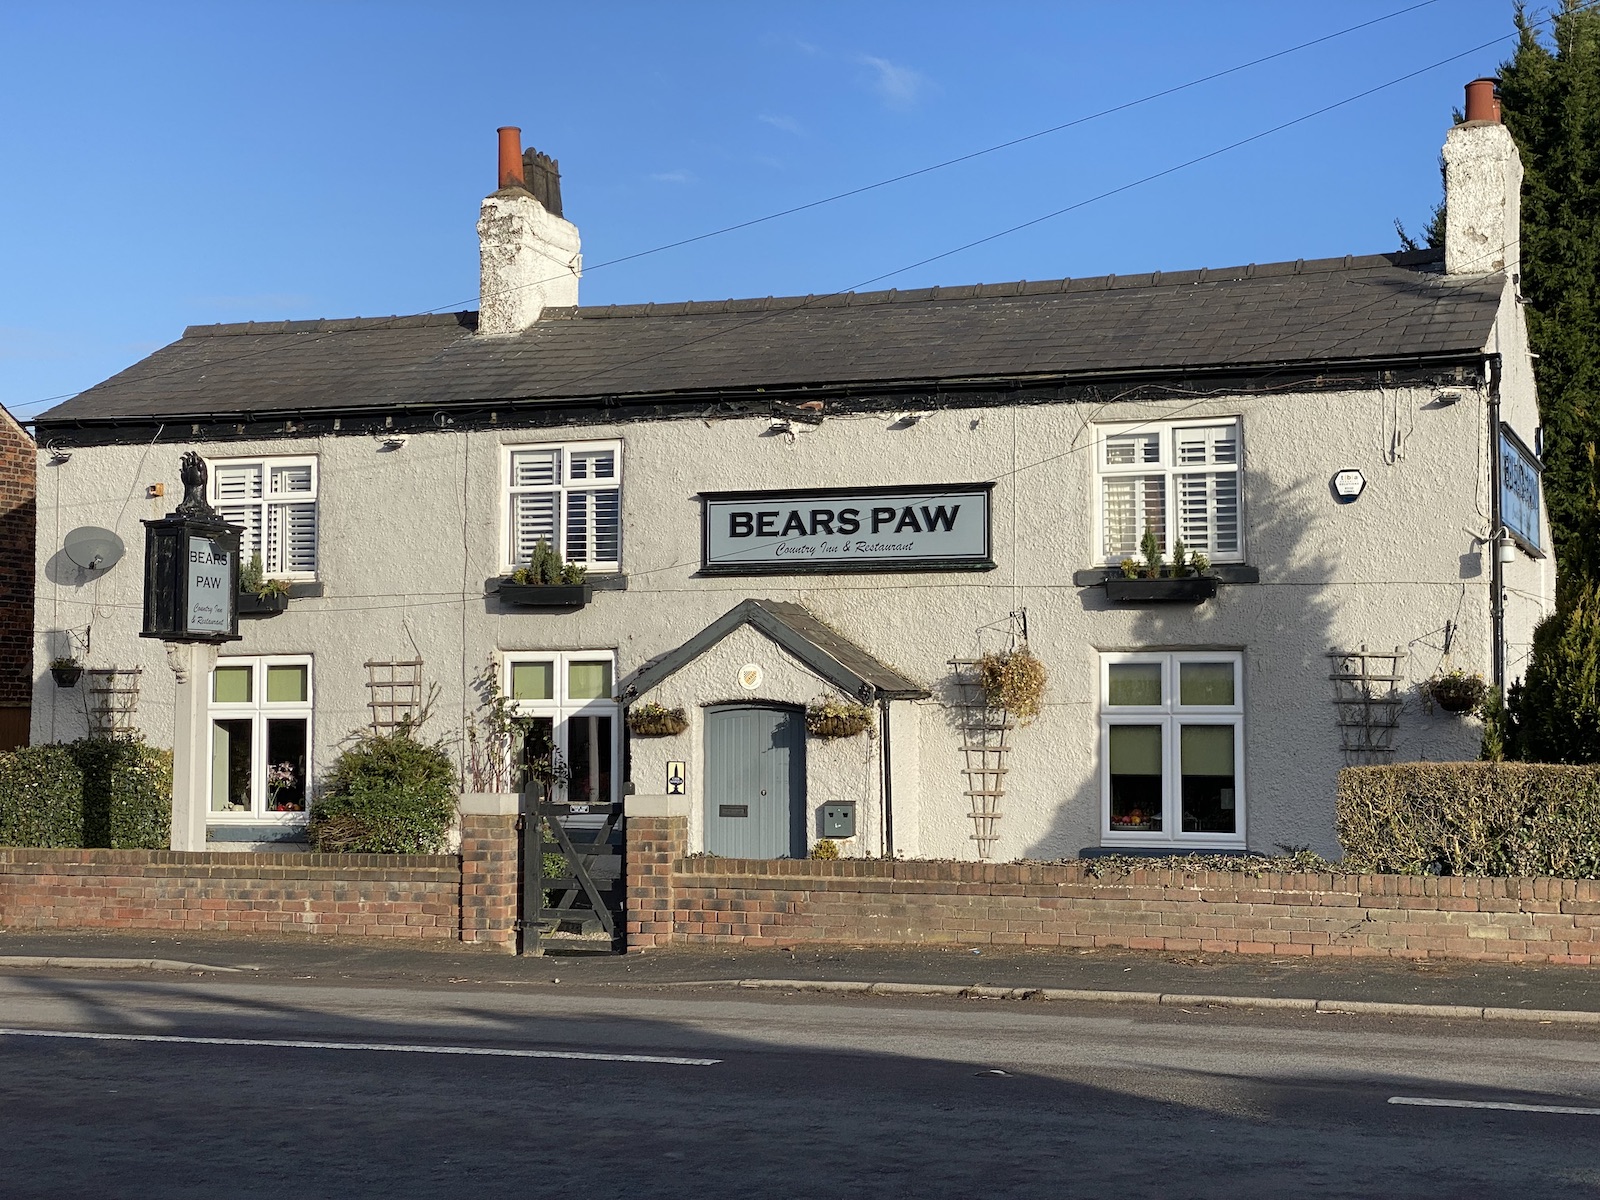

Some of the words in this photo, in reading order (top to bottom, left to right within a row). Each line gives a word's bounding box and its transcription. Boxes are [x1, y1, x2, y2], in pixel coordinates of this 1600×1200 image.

[729, 508, 861, 538] BEARS
[870, 504, 961, 534] PAW
[775, 541, 815, 556] Country
[820, 541, 838, 554] Inn
[842, 540, 851, 553] &
[855, 541, 914, 553] Restaurant
[190, 551, 228, 566] BEARS
[196, 576, 221, 589] PAW
[193, 602, 213, 614] Country
[197, 616, 224, 626] Restaurant
